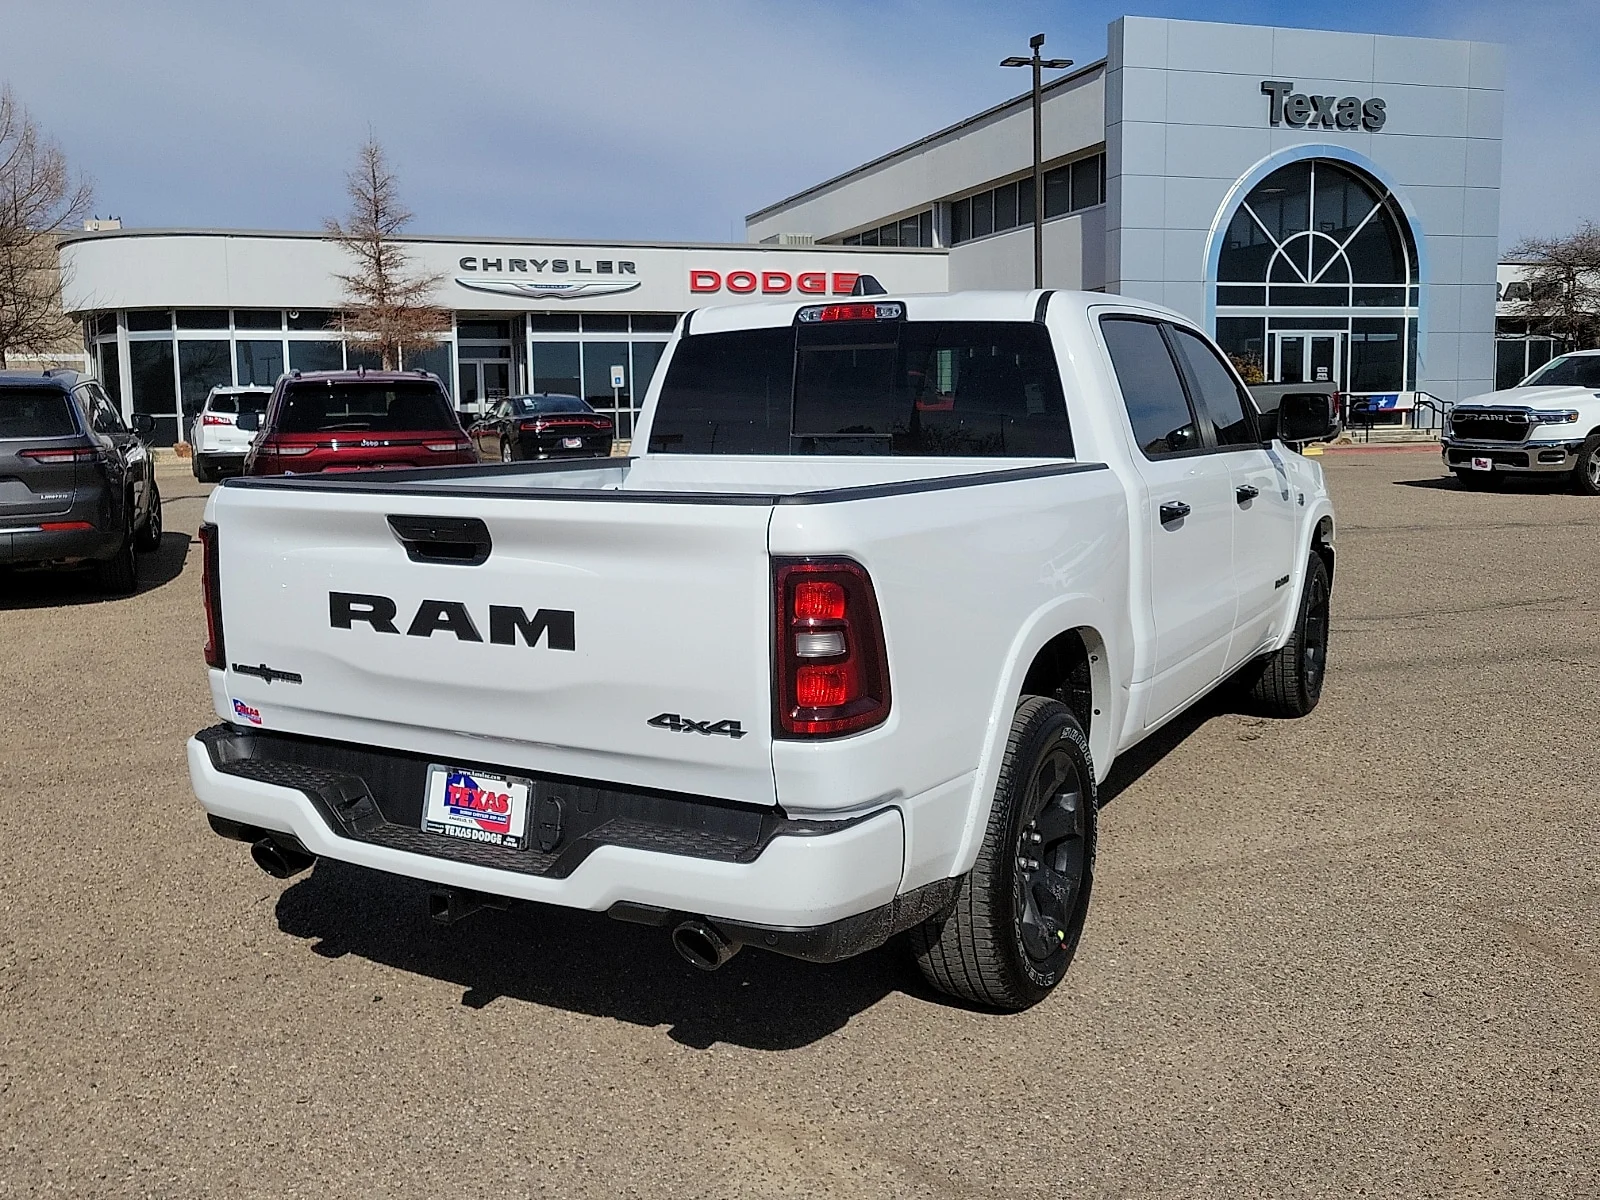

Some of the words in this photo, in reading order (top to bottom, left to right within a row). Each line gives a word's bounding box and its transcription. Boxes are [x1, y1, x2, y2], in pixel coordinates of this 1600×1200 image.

[1260, 80, 1387, 132] Texas
[459, 256, 637, 274] CHRYSLER
[689, 270, 860, 296] DODGE
[329, 591, 576, 652] RAM
[448, 785, 509, 813] TEXAS
[445, 824, 471, 839] TEXAS
[472, 830, 502, 844] DODGE
